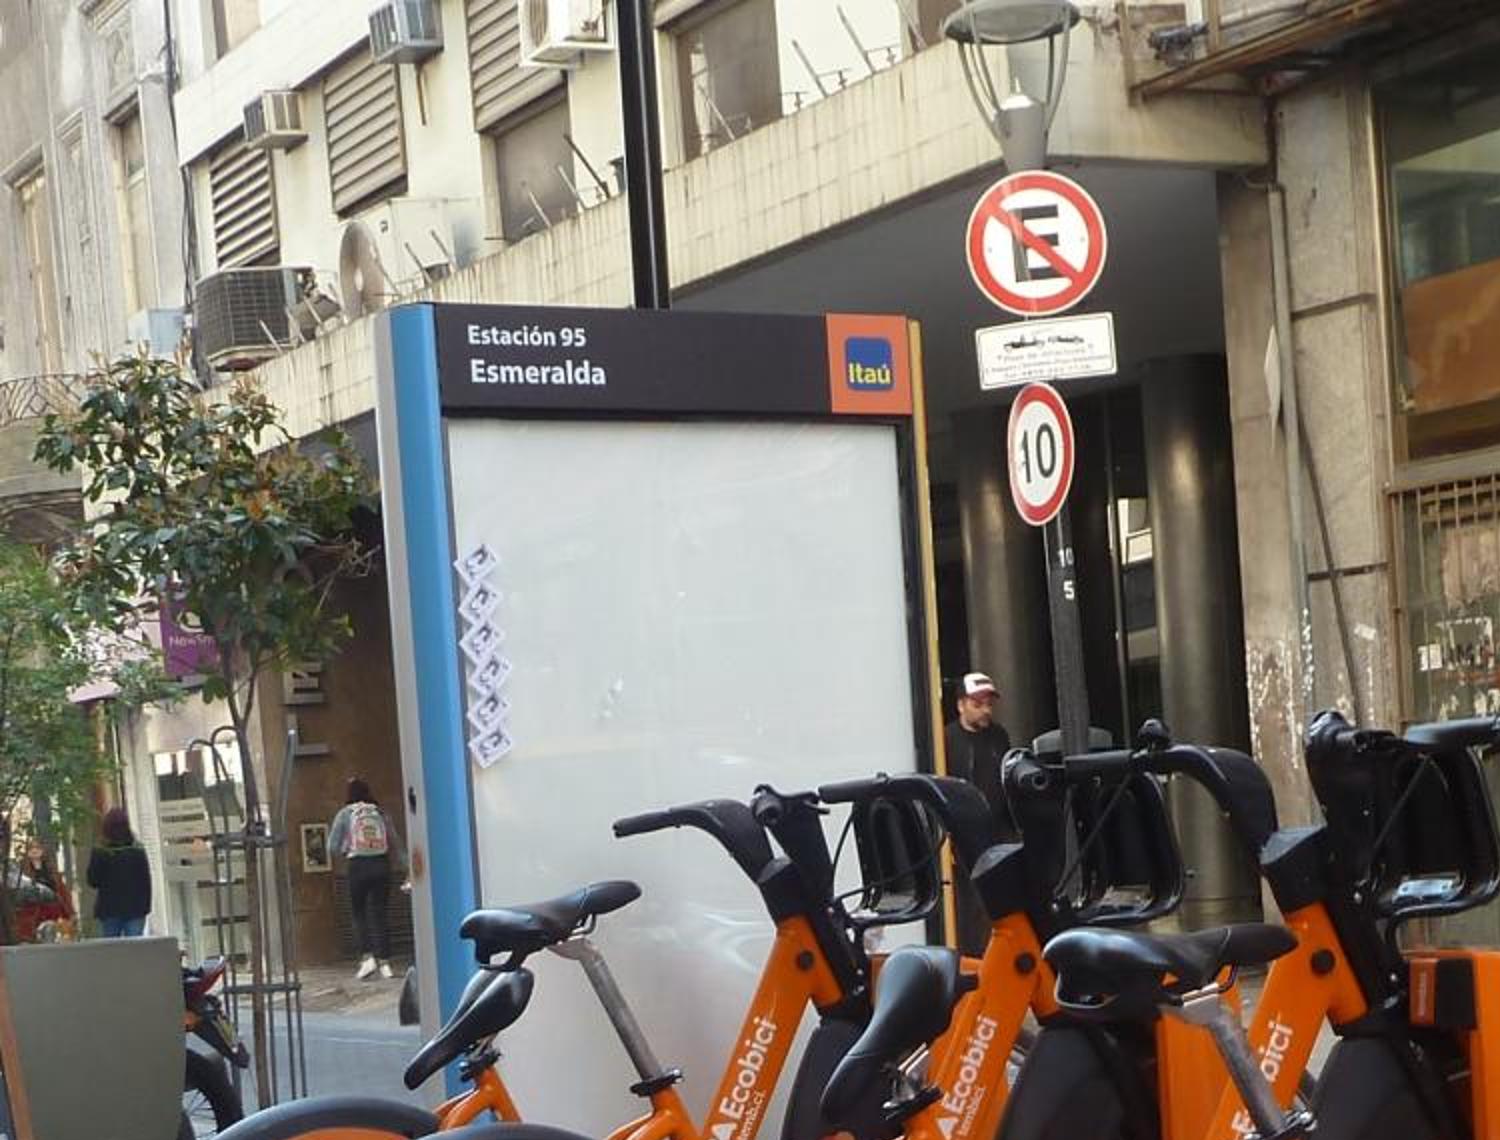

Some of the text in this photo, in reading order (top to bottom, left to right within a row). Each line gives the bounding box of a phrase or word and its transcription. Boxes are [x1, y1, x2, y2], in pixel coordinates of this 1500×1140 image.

[1009, 203, 1064, 282] E
[467, 324, 587, 347] Estación 95
[470, 358, 607, 385] Esmeralda
[848, 362, 892, 384] Itaú
[1020, 422, 1057, 484] 10
[1063, 580, 1075, 600] 5
[719, 1015, 777, 1120] Ecobici
[941, 1014, 998, 1115] Ecobici
